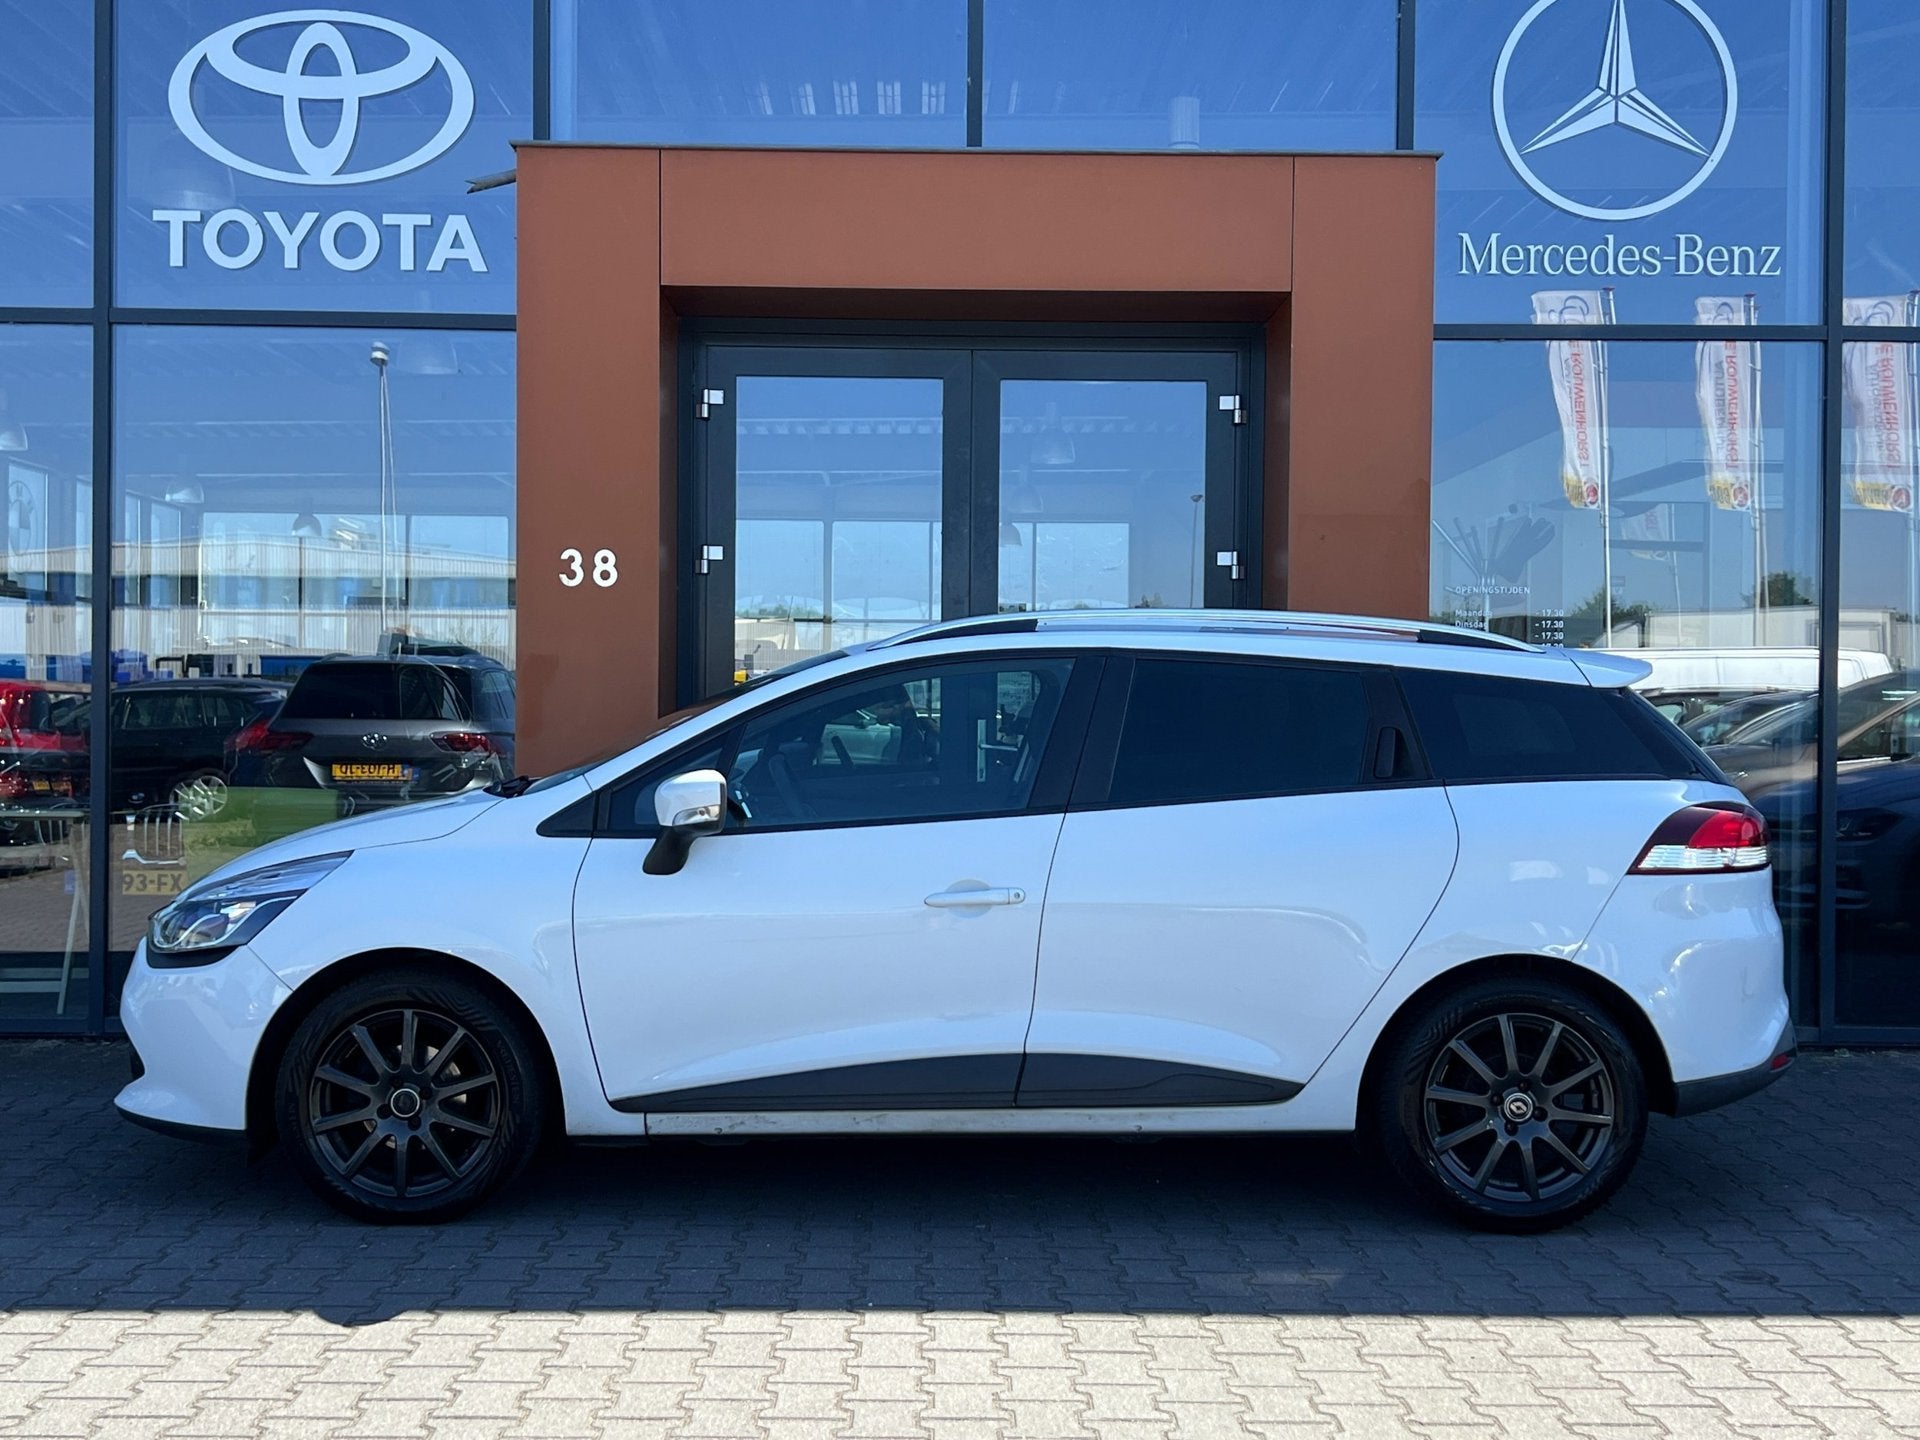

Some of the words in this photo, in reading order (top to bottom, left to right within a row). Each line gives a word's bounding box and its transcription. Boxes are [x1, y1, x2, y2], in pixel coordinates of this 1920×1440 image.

[152, 208, 489, 273] TOYOTA
[1457, 232, 1782, 276] Mercedes-Benz
[559, 548, 618, 587] 38
[1455, 586, 1531, 595] OPENINGSTIJDEN
[1542, 609, 1564, 617] 17.30
[1541, 620, 1564, 628] 17.30
[1541, 632, 1564, 640] 17.30
[123, 873, 182, 893] 93-FX
